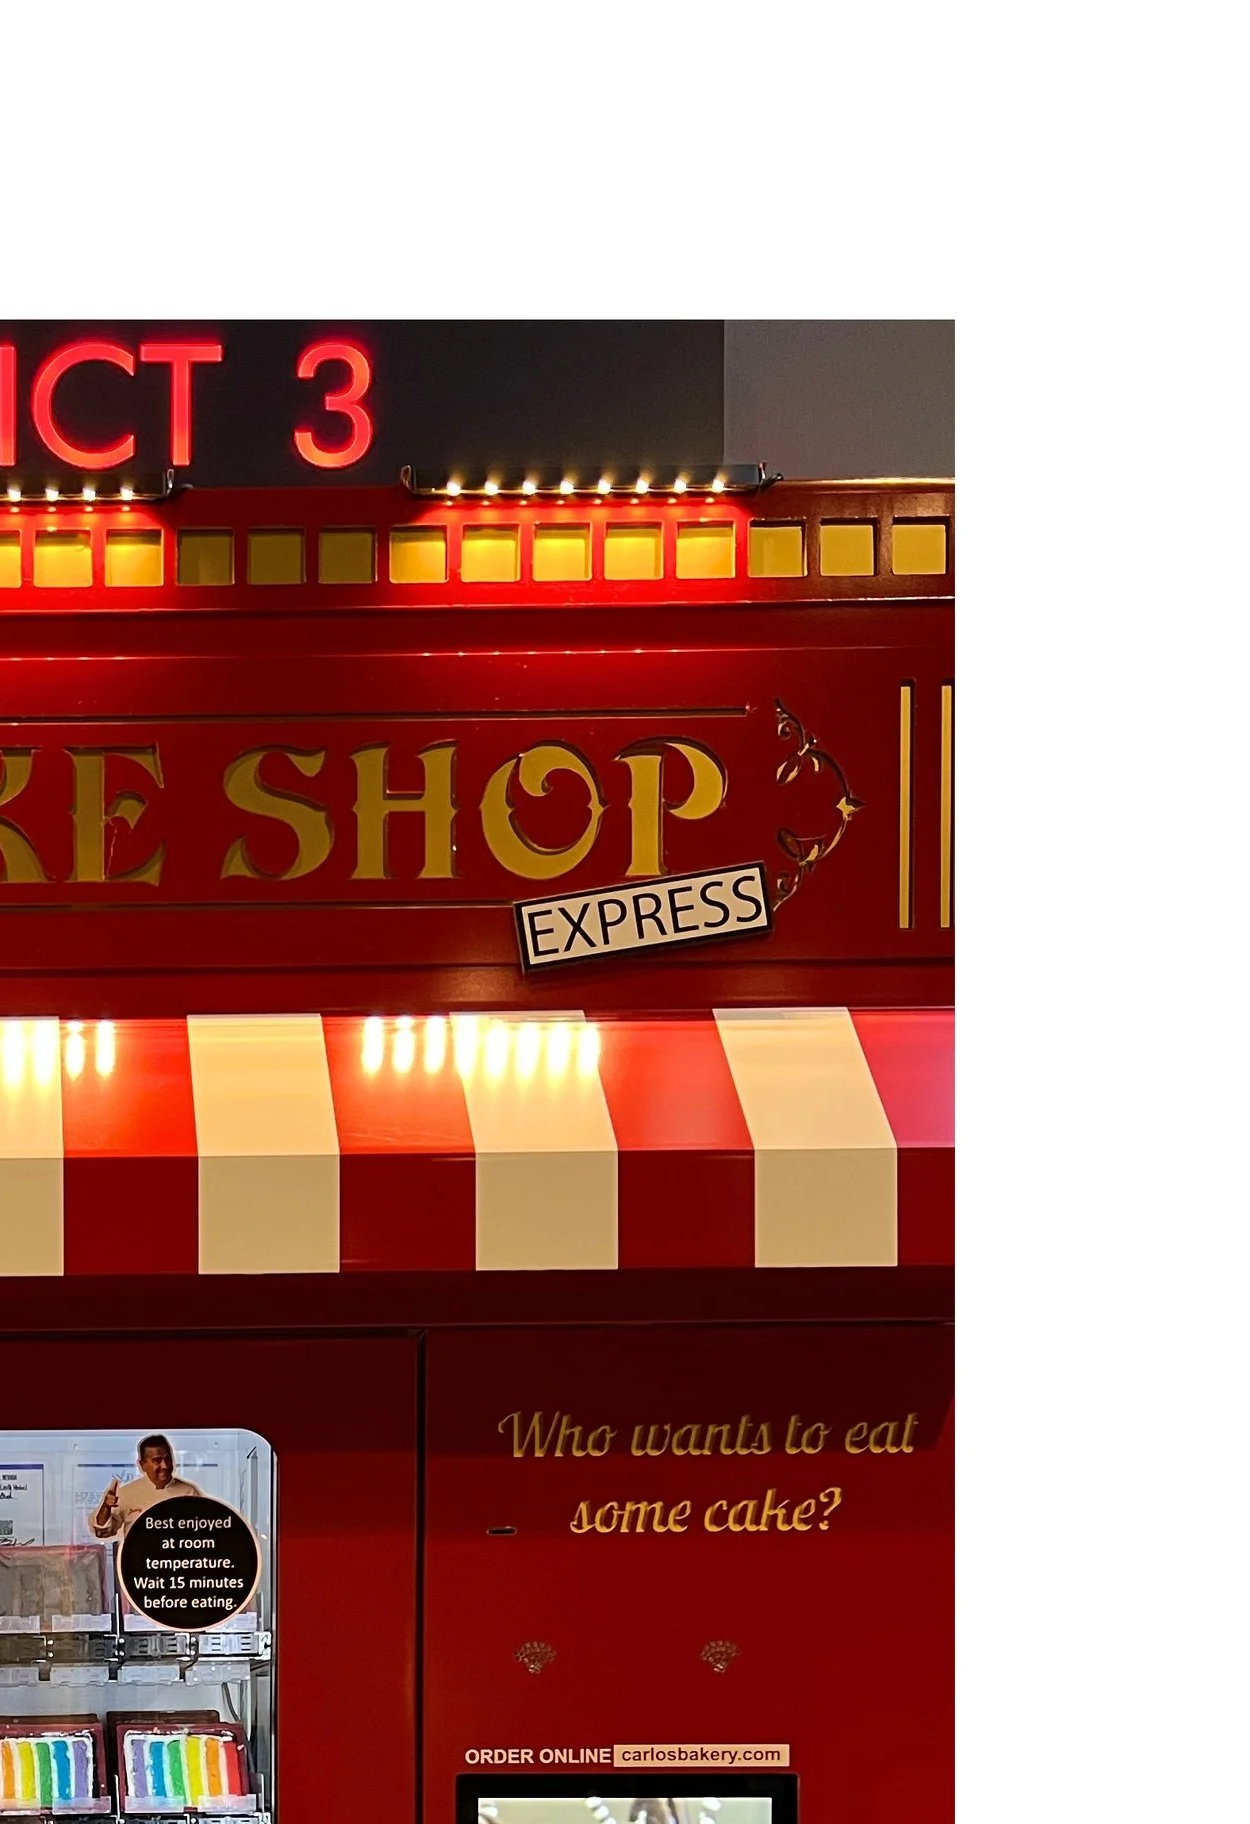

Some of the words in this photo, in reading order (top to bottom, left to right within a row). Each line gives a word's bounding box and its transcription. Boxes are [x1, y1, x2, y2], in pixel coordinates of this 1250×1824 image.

[293, 342, 374, 469] 3
[220, 736, 729, 884] SHOP
[527, 874, 766, 960] EXPRESS
[498, 1411, 617, 1458] Who
[630, 1413, 772, 1456] wants
[784, 1414, 832, 1455] to
[844, 1412, 920, 1455] eat
[569, 1499, 692, 1533] some
[703, 1487, 843, 1532] cake?
[145, 1517, 174, 1529] Best
[178, 1516, 232, 1531] enjoyed
[162, 1538, 175, 1549] at
[179, 1539, 215, 1549] room
[146, 1557, 235, 1571] temperature.
[134, 1577, 165, 1589] Wait
[169, 1577, 185, 1589] 15
[189, 1576, 243, 1589] minutes
[144, 1596, 187, 1608] before
[191, 1597, 238, 1610] eating.
[464, 1748, 535, 1764] ORDER
[539, 1748, 612, 1764] ONLINE
[621, 1747, 781, 1765] carlosbakery.com
